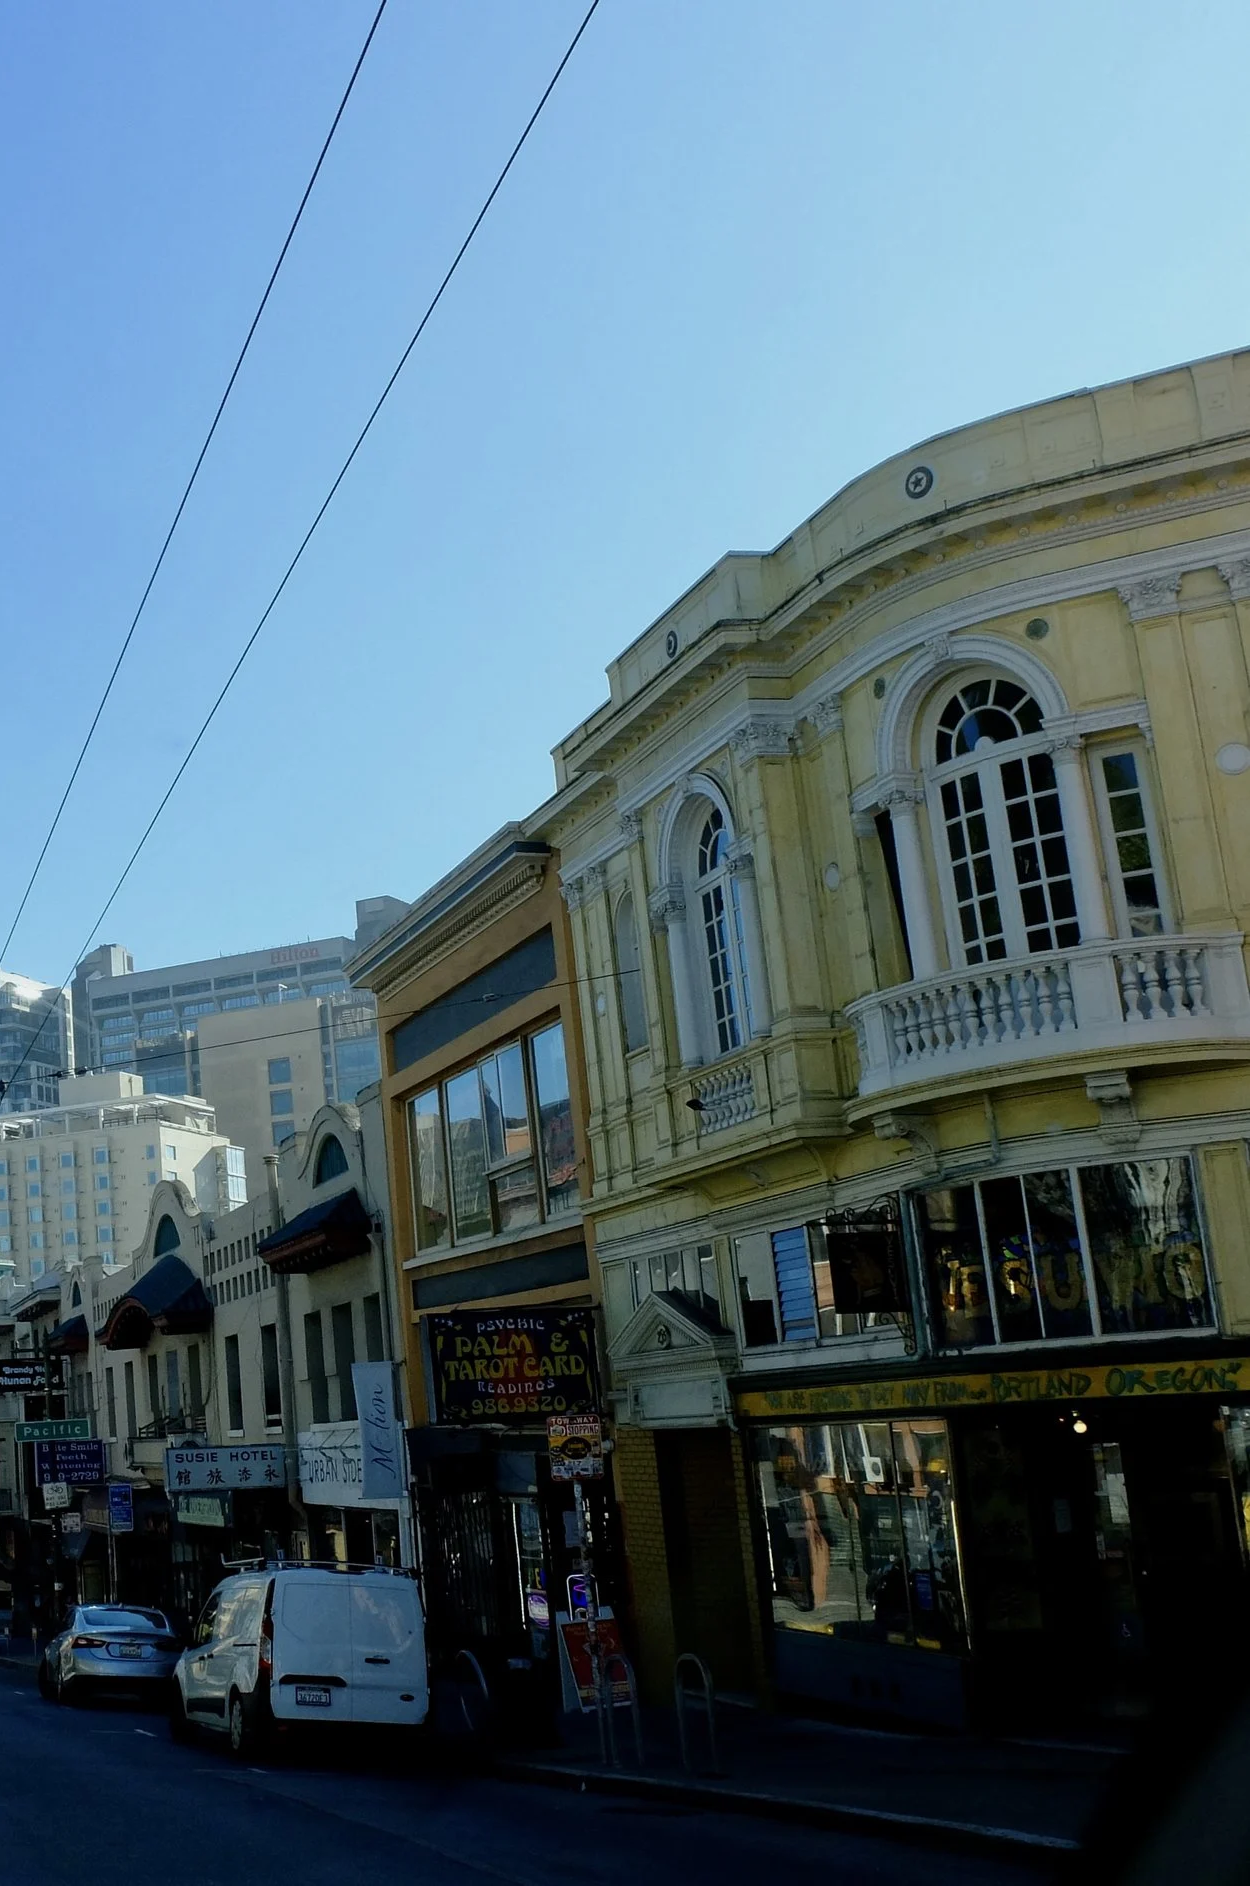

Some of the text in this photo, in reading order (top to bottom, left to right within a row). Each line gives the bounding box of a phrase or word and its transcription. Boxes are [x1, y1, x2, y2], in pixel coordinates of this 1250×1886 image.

[270, 947, 320, 964] Hilton
[477, 1317, 546, 1334] PSYCHIC
[454, 1331, 570, 1357] PALM &
[444, 1353, 586, 1381] TAROT CARD
[33, 1375, 59, 1386] Fod
[477, 1378, 556, 1394] READINGS
[990, 1372, 1091, 1402] PORTLAND
[23, 1424, 81, 1436] Pacific
[42, 1442, 99, 1452] Bite Smile
[175, 1450, 277, 1463] SUSIE HOTEL
[40, 1462, 102, 1470] Witening
[308, 1458, 363, 1483] URBAN SIDE
[43, 1471, 99, 1481] 99-2729
